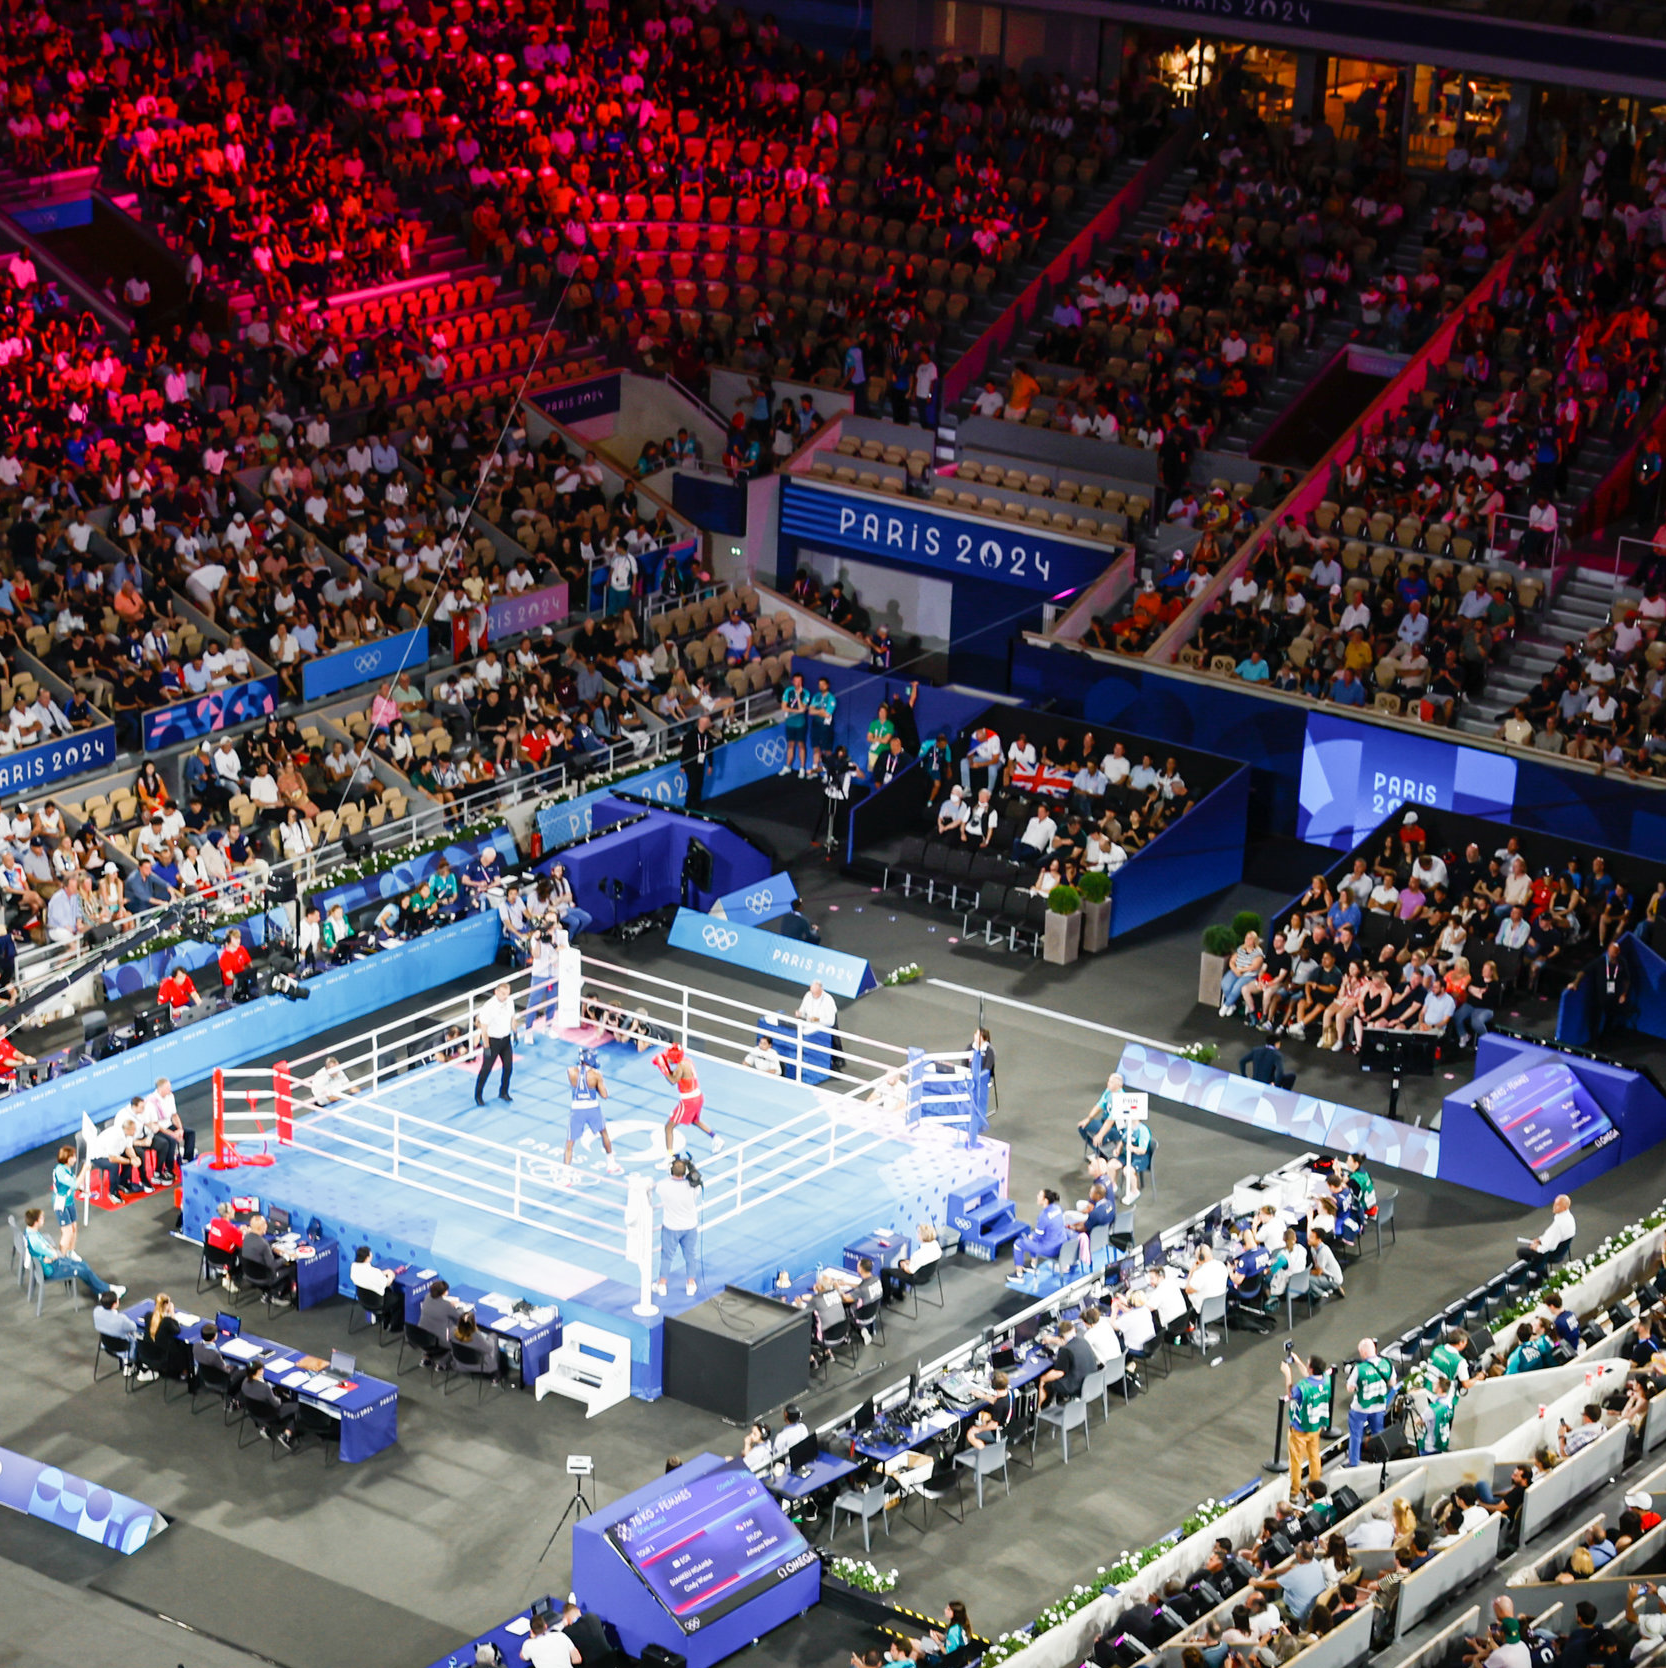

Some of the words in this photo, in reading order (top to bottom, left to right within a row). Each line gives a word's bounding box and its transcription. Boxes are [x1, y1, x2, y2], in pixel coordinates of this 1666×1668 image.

[956, 534, 1050, 581] 2024
[488, 610, 511, 631] RIS
[518, 596, 560, 623] 2024
[52, 739, 104, 772] 2024
[1373, 794, 1402, 814] 20
[658, 1488, 693, 1512] FEMMES
[786, 1549, 818, 1573] OMEGA
